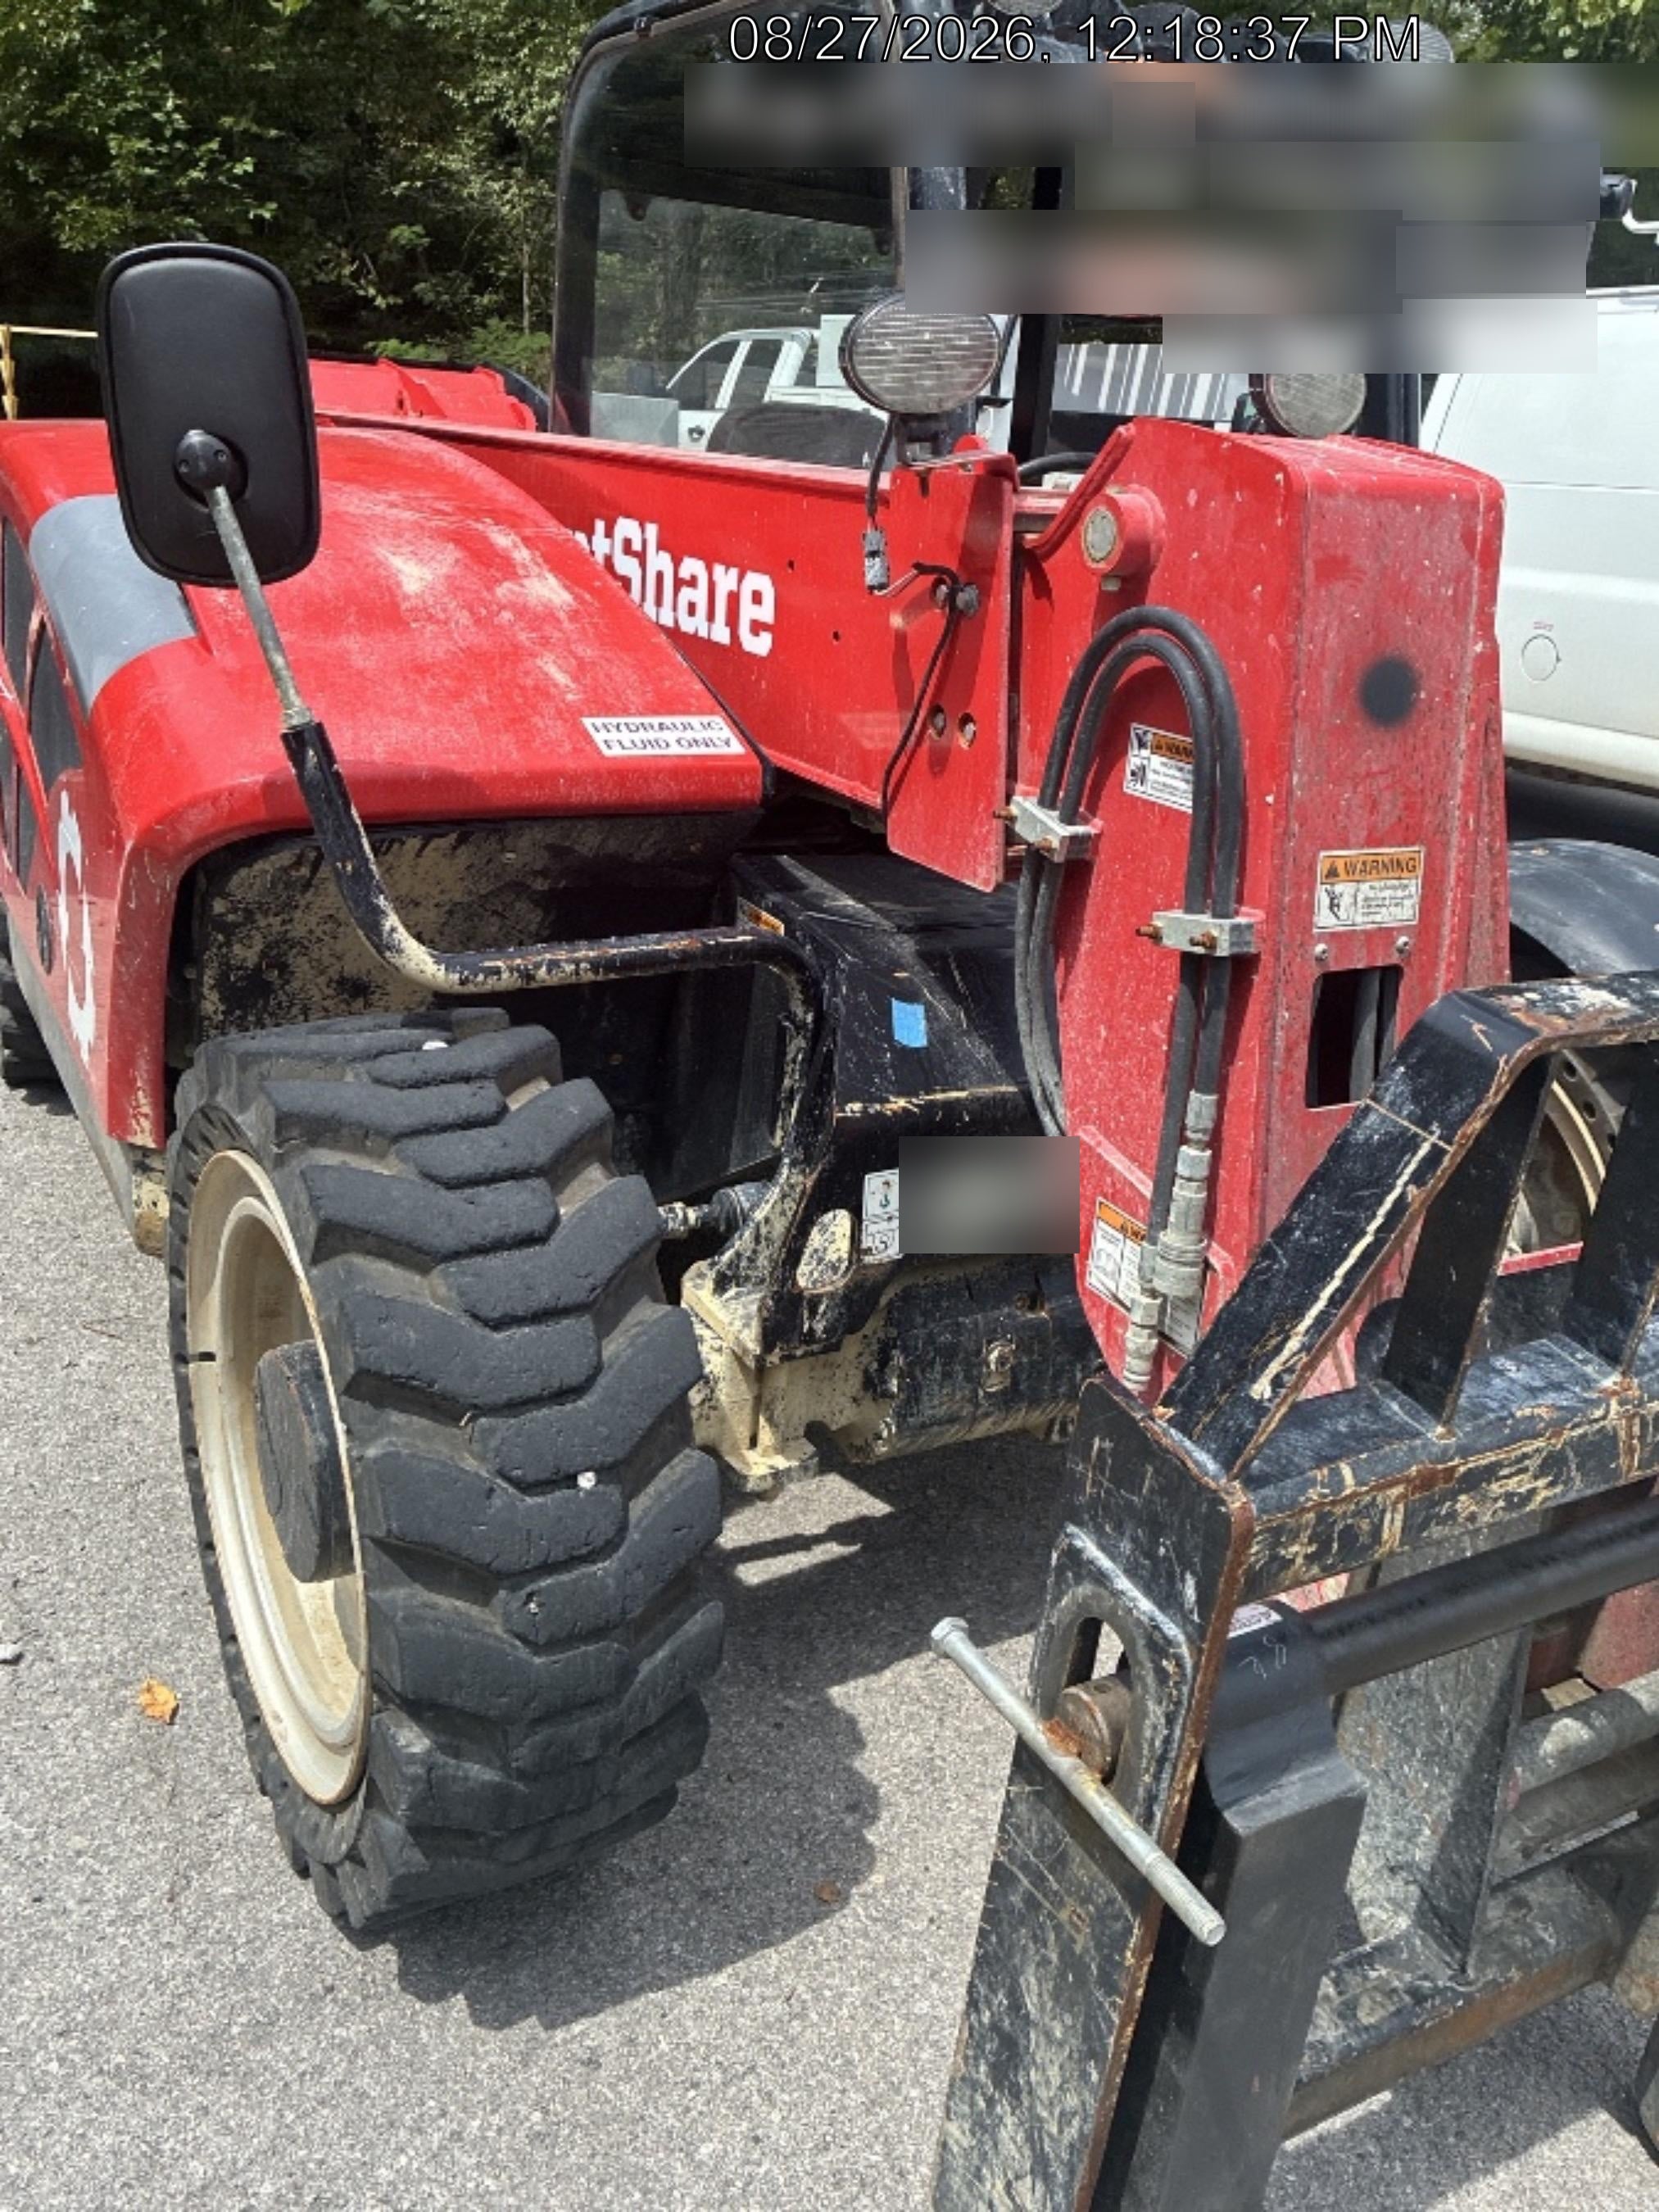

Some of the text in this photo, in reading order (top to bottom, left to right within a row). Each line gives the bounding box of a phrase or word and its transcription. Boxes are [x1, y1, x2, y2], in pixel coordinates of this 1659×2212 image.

[573, 516, 775, 657] tShare
[591, 719, 724, 733] HYDRAULIC
[602, 737, 732, 750] FLUID ONLY
[1344, 857, 1417, 877] WARNING
